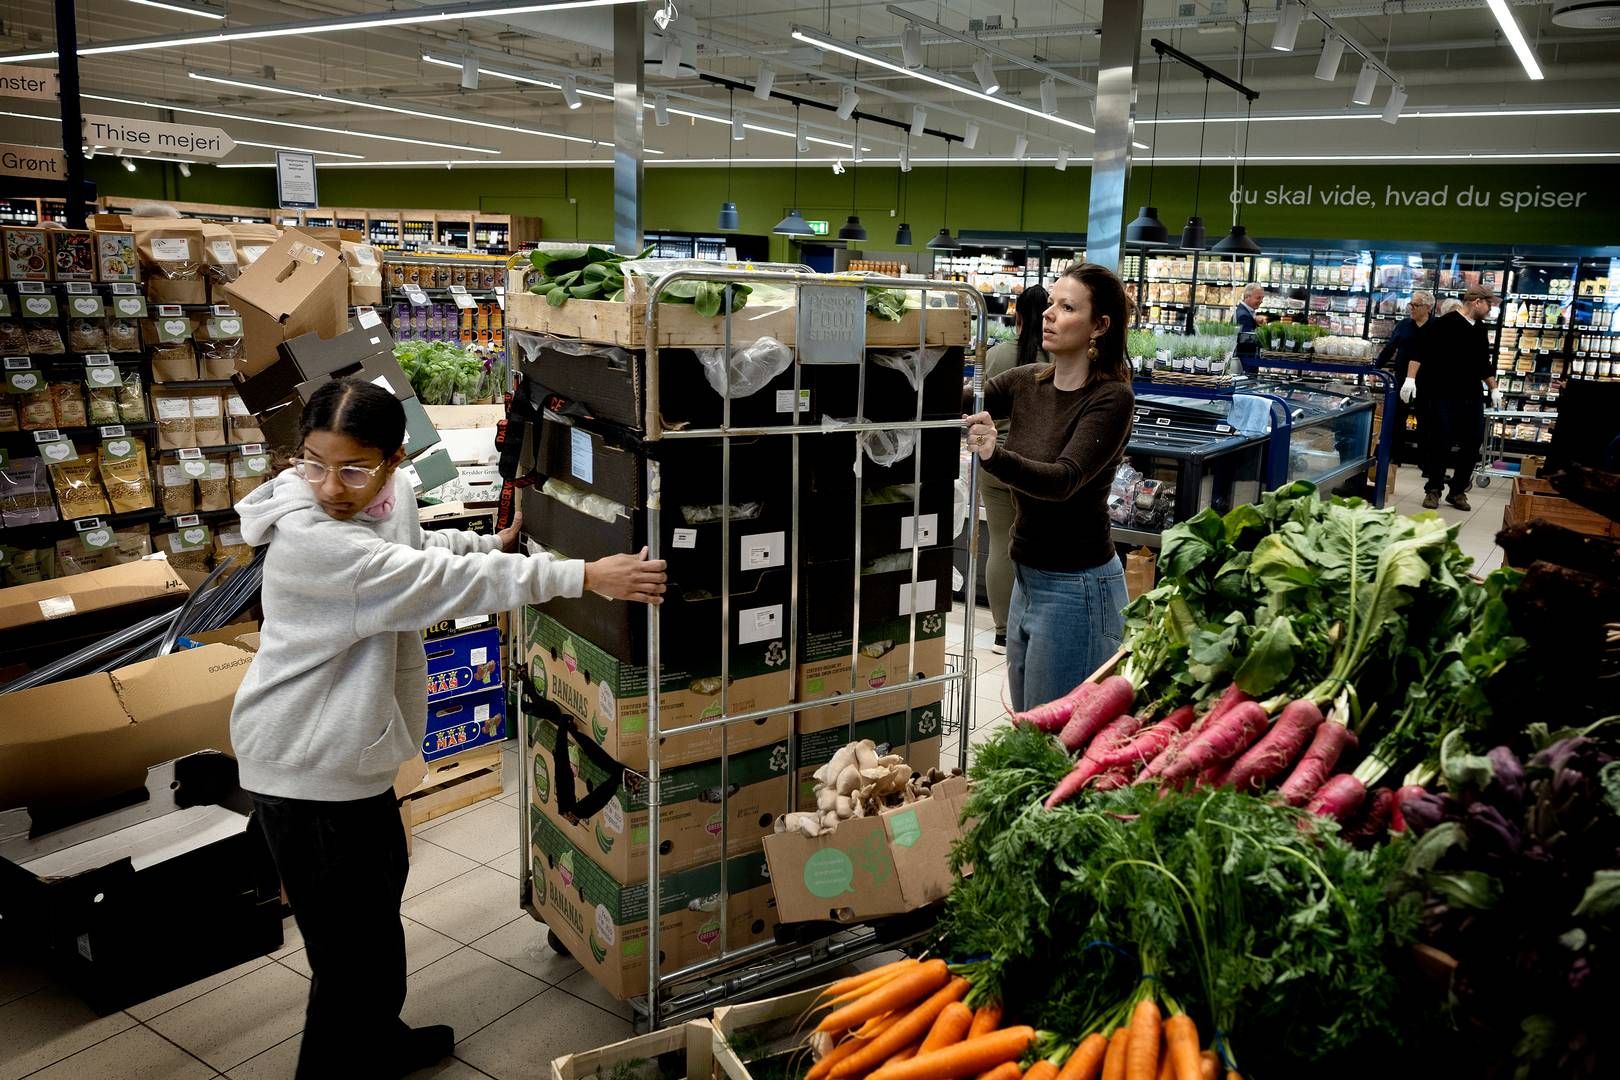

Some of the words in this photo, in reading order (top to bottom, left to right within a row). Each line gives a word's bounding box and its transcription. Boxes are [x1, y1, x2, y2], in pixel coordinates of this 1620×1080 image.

[91, 123, 150, 144] Thise
[158, 133, 220, 152] mejeri
[2, 153, 57, 173] Grønt
[1229, 185, 1257, 206] du
[1264, 185, 1312, 206] skal
[1319, 185, 1377, 209] vide,
[1385, 186, 1447, 207] hvad
[1456, 186, 1490, 207] du
[1498, 185, 1587, 212] spiser
[551, 674, 589, 718] BANANAS
[549, 881, 584, 934] BANANAS
